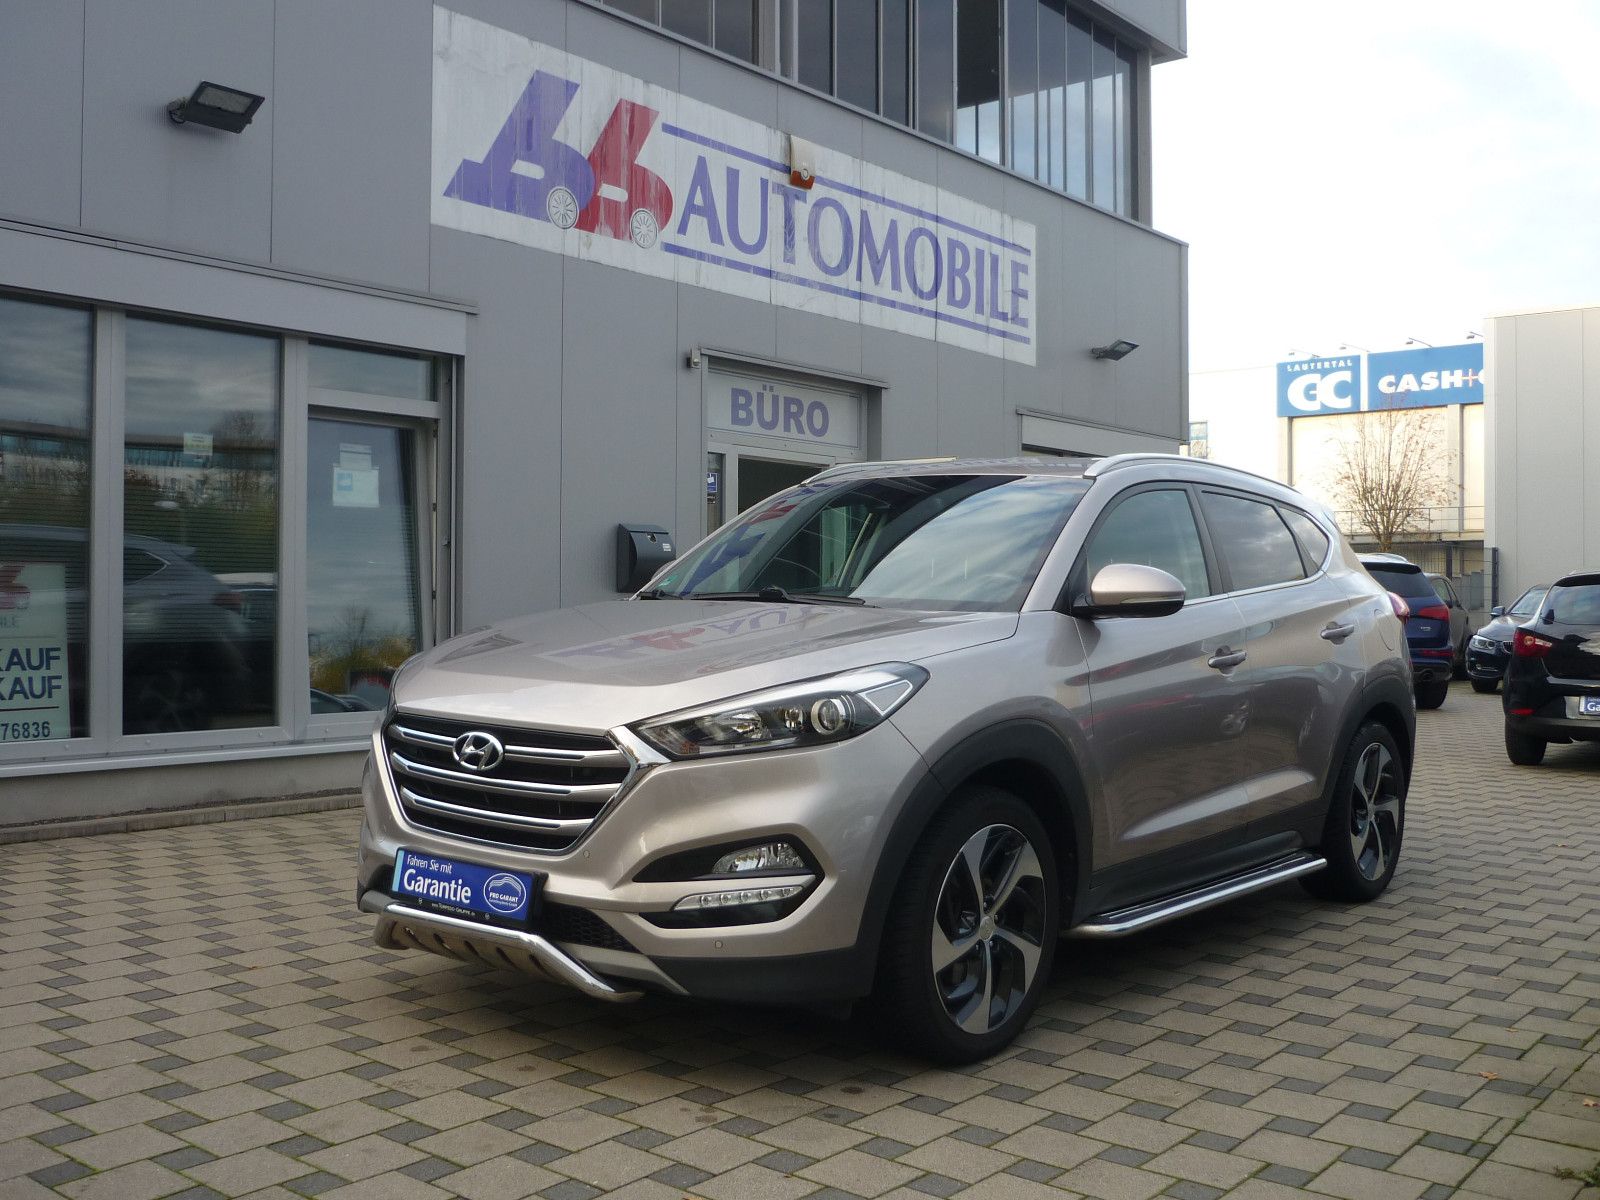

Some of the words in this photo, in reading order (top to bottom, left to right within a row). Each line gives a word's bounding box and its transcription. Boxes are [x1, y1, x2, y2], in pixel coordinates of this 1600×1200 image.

[677, 155, 1030, 329] AUTOMOBILE
[1287, 359, 1353, 372] LAUTERTAL
[730, 384, 829, 437] BÜRO
[0, 647, 61, 672] AUF
[407, 854, 428, 869] Fahren
[429, 859, 439, 871] Sie
[440, 862, 452, 874] mit
[403, 868, 471, 904] Garantie
